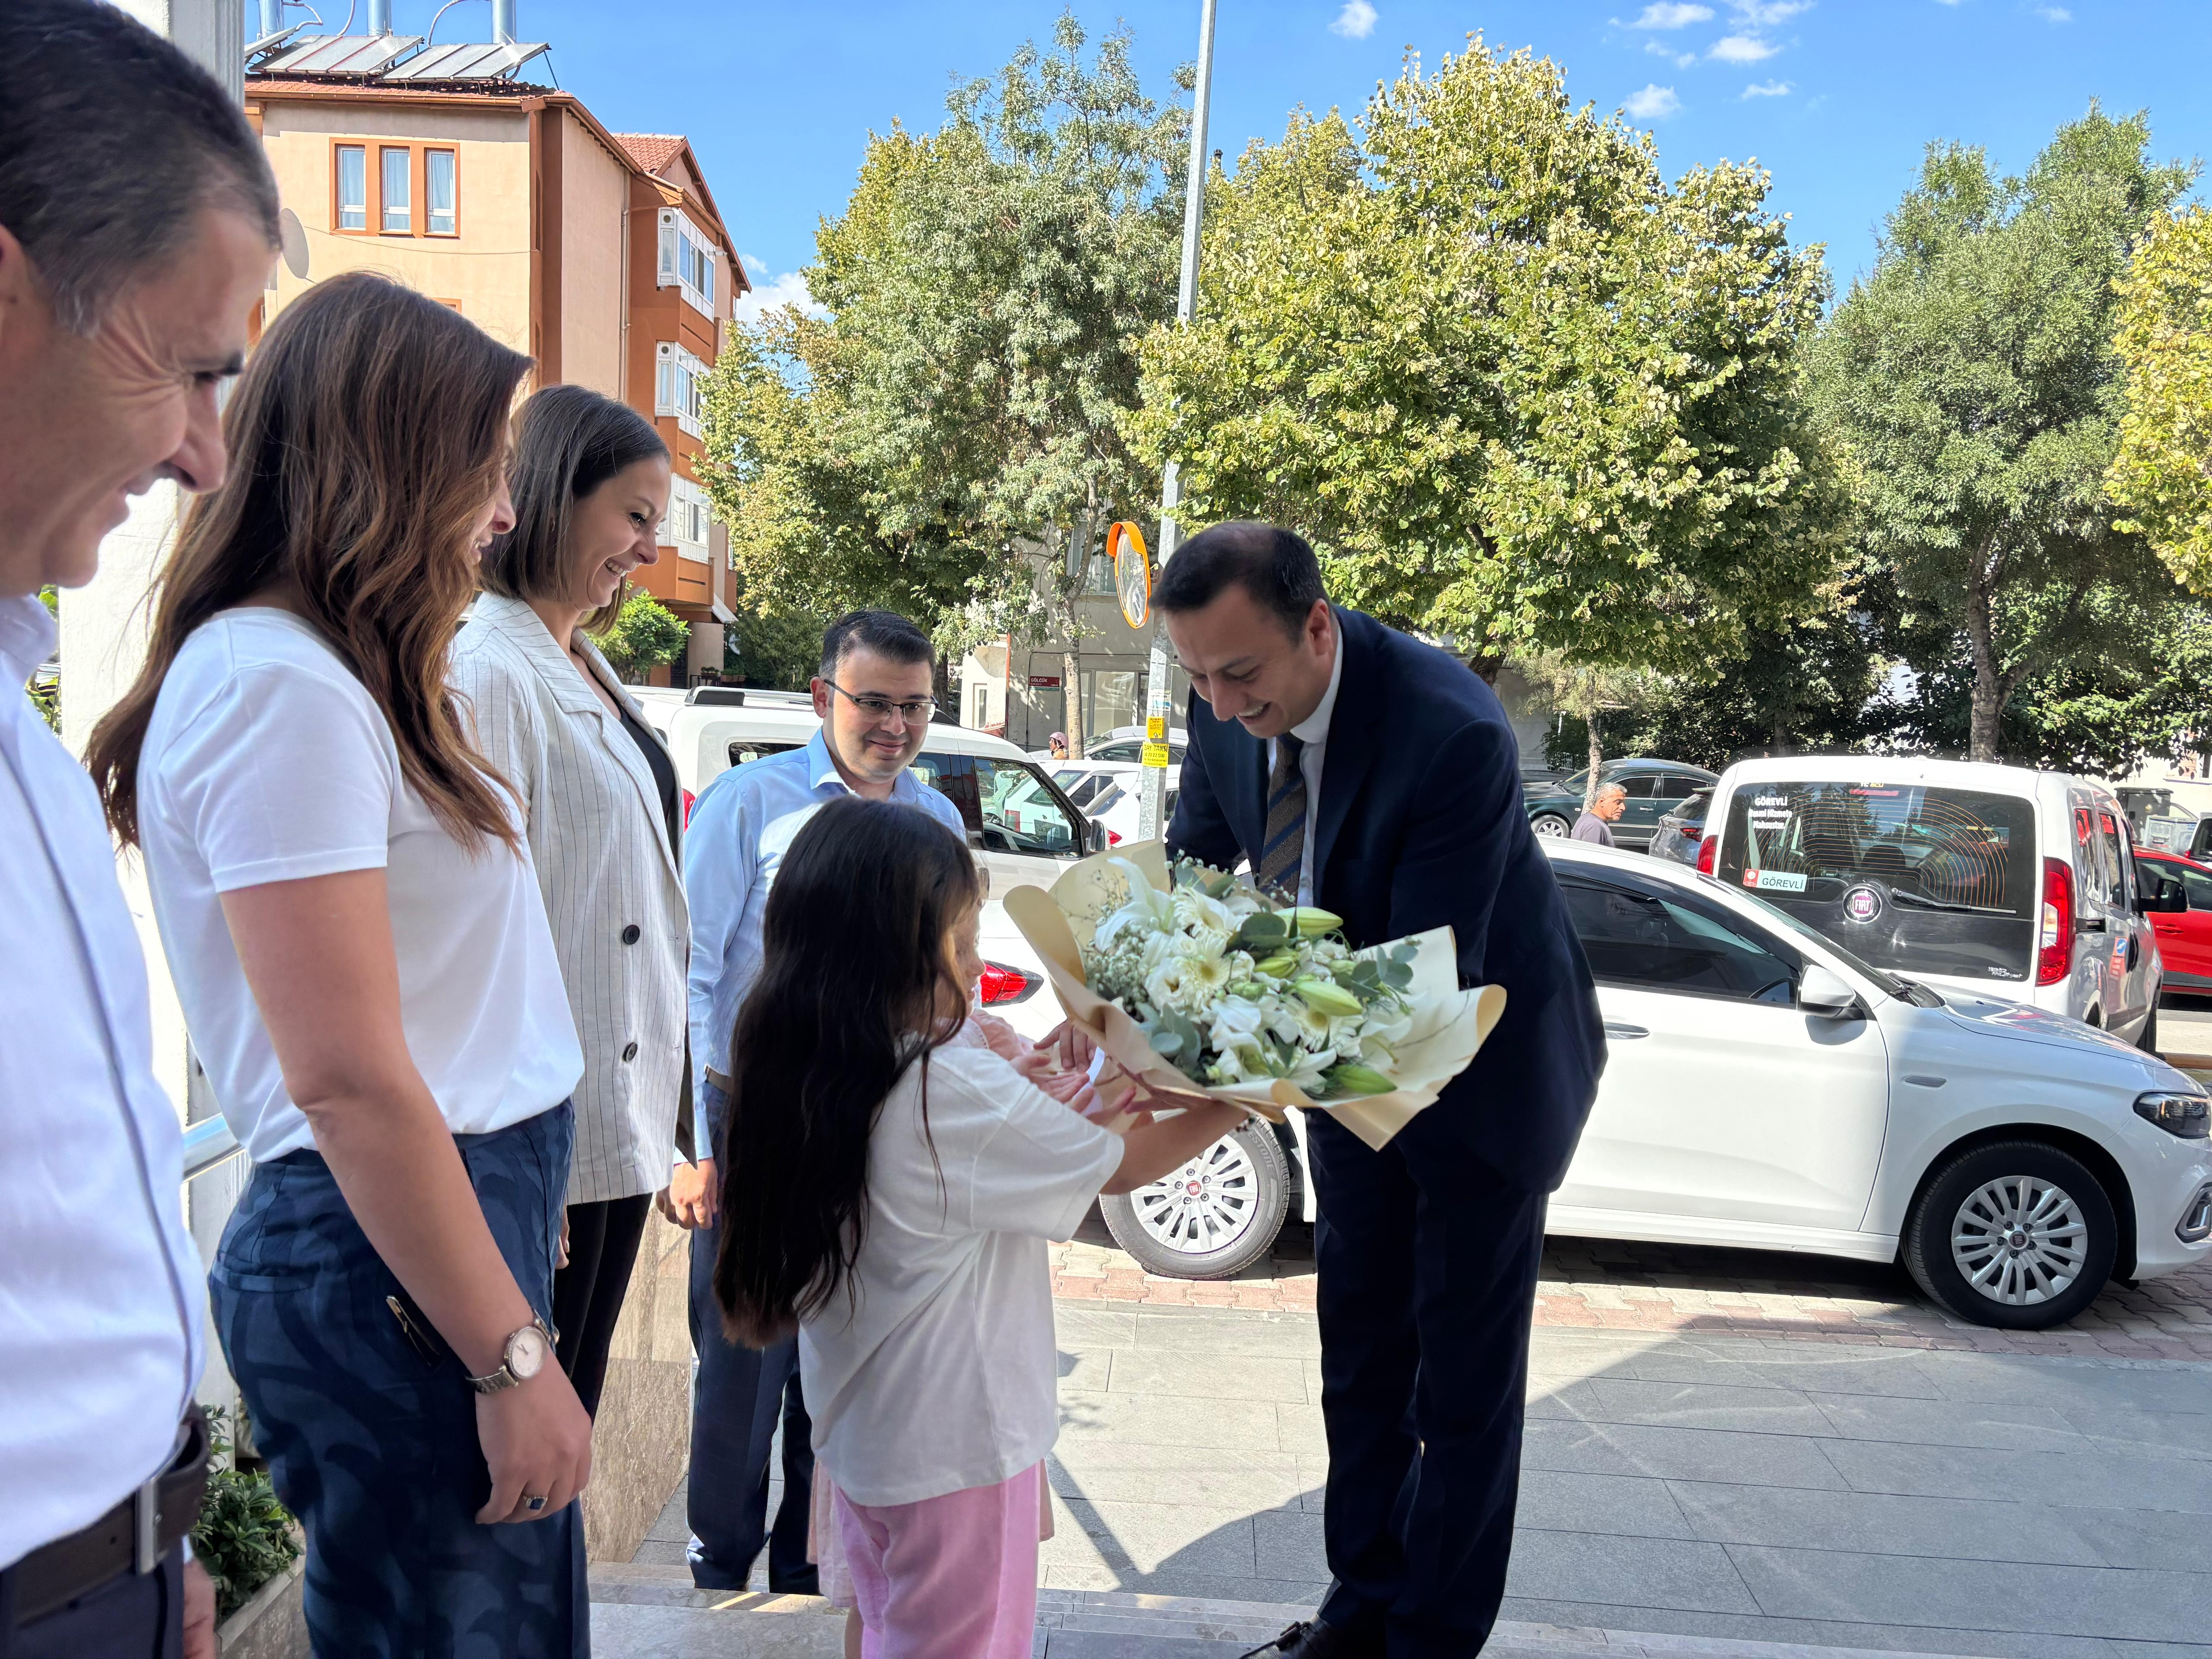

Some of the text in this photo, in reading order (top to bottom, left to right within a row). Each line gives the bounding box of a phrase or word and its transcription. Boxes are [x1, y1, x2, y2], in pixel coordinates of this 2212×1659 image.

[1754, 796, 1788, 806] GÖREVLİ
[1762, 876, 1804, 889] GÖREVLİ
[1855, 899, 1871, 912] FIAT
[1248, 1130, 1274, 1170] ESTONE
